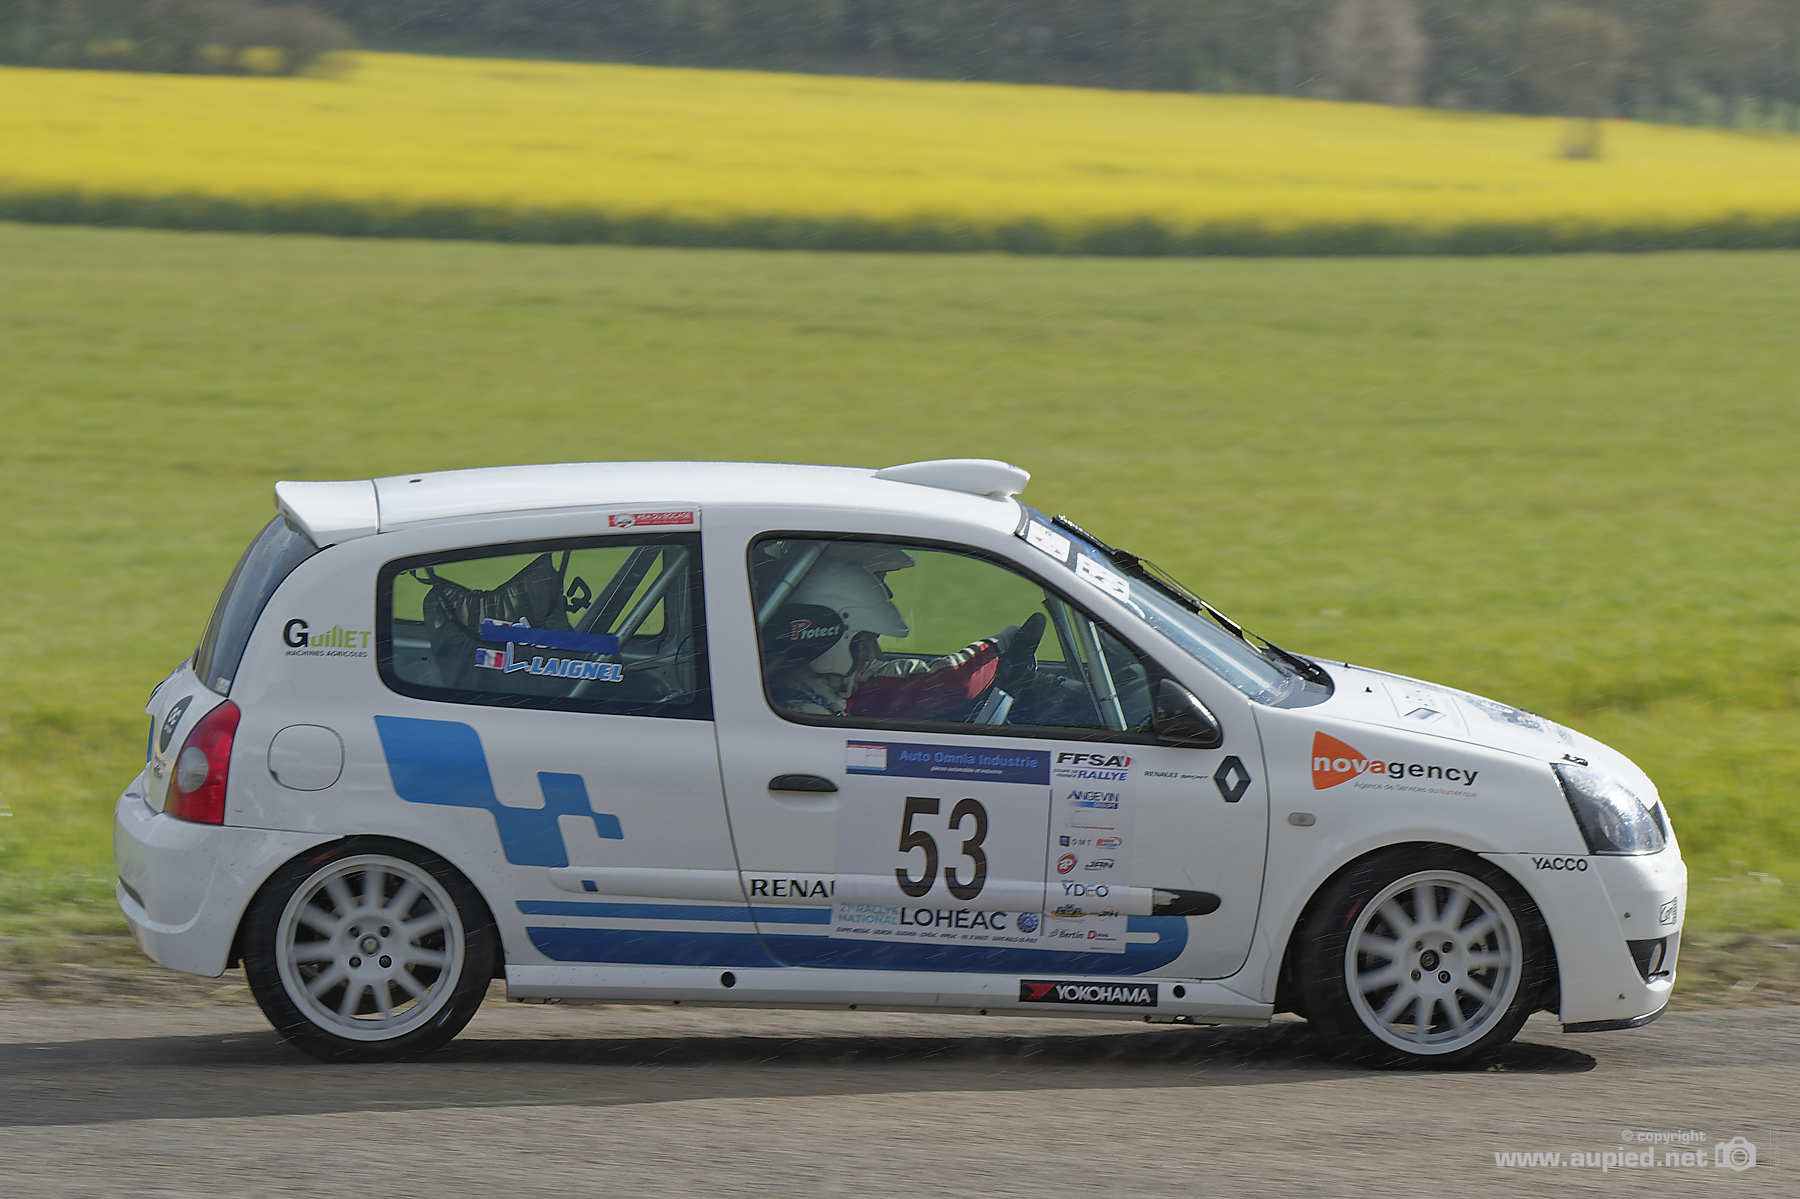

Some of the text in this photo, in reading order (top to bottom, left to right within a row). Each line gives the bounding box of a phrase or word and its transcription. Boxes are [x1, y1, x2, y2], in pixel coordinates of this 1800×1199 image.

[790, 618, 840, 641] Protect
[898, 749, 1039, 769] Auto Omnia Industrie
[1056, 752, 1122, 768] FFSA
[1077, 770, 1129, 781] RALLYE
[1313, 754, 1480, 787] novagency
[895, 796, 989, 900] 53
[1532, 856, 1589, 873] YACCO
[900, 907, 1008, 931] LOHÉAC
[1055, 985, 1152, 1003] YOKOHAMA
